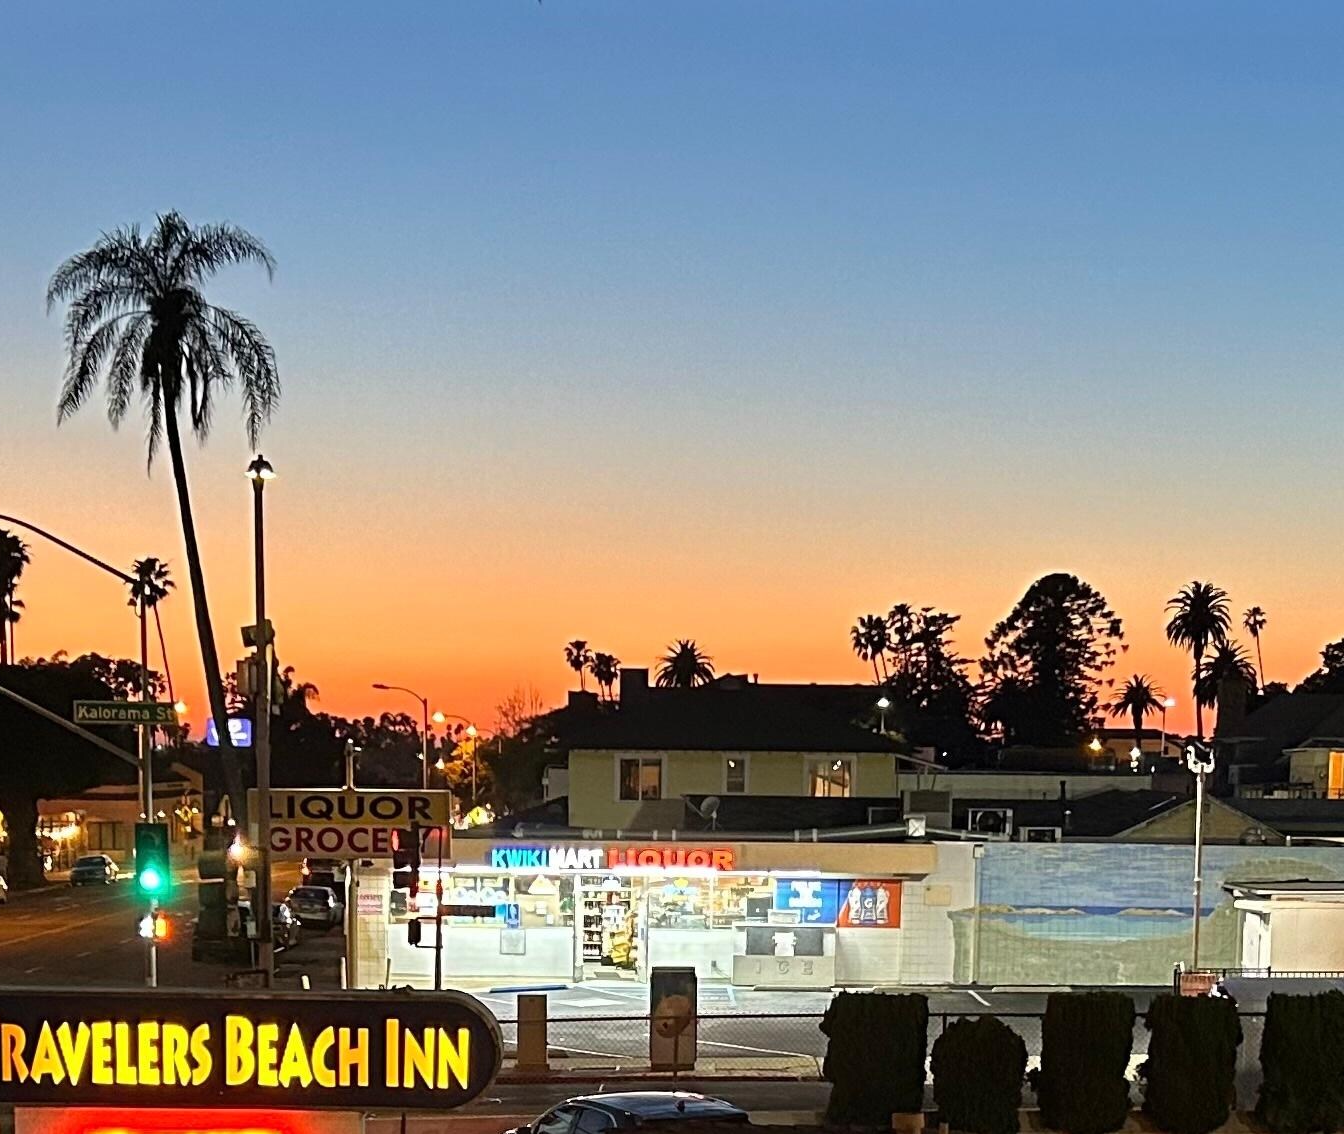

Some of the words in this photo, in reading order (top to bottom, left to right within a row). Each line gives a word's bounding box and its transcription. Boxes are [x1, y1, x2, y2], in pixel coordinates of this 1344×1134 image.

[77, 705, 150, 720] Kalorama
[156, 706, 174, 721] St
[269, 795, 432, 820] LIQUOR
[548, 847, 603, 868] MART
[607, 847, 734, 871] LIQUOR
[755, 959, 814, 975] ICE
[225, 1014, 369, 1088] BEACH
[385, 1018, 470, 1089] INN
